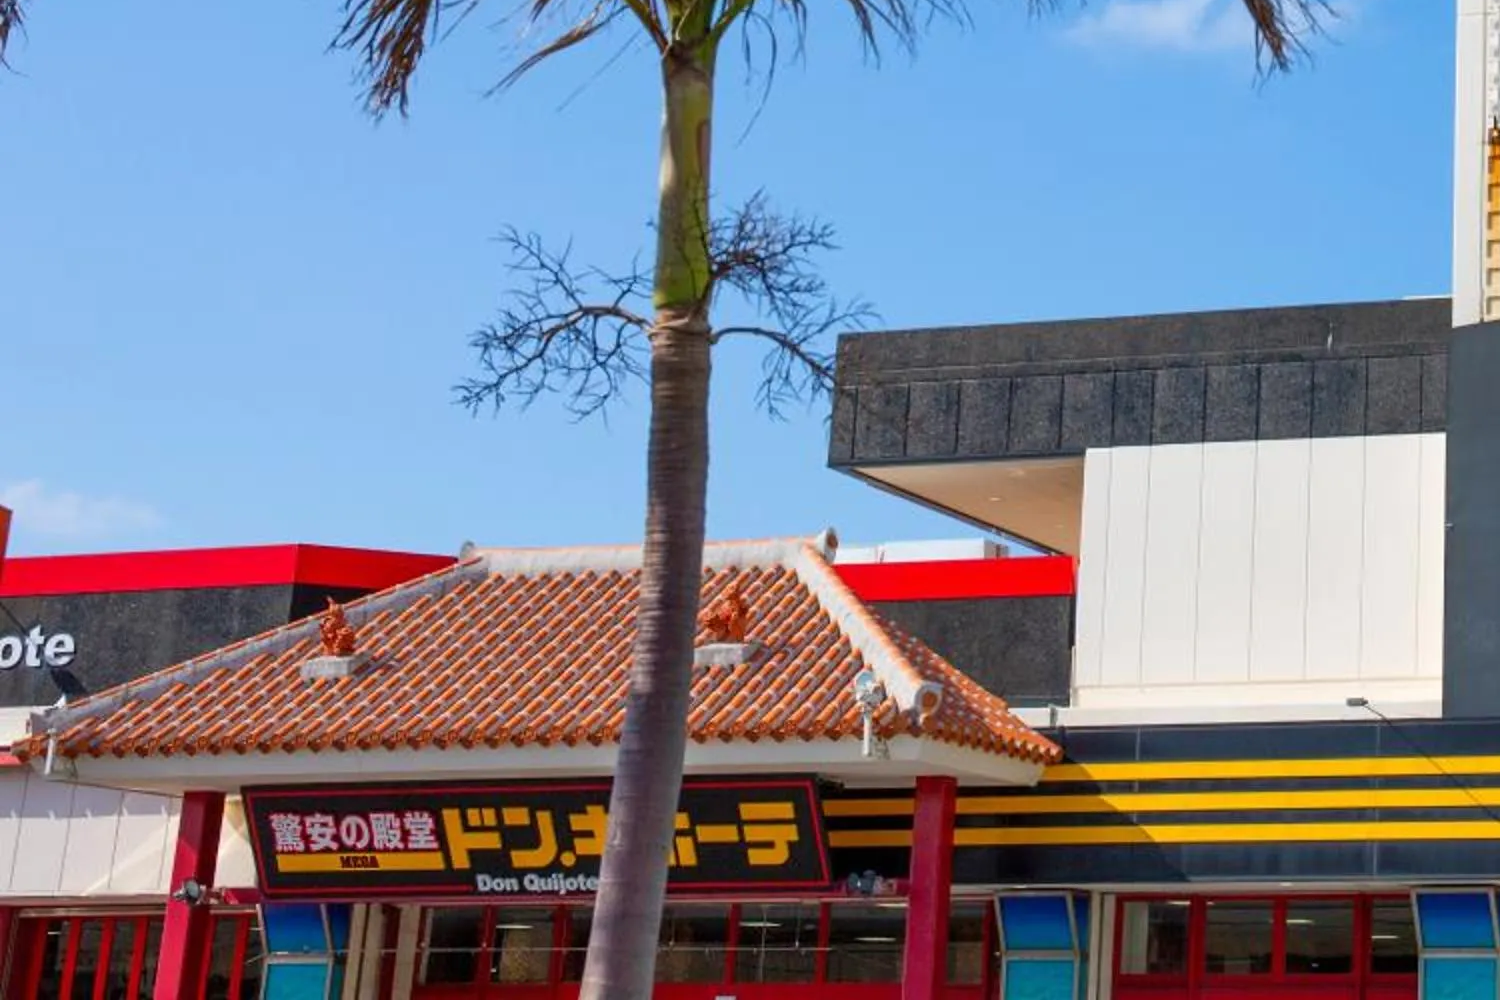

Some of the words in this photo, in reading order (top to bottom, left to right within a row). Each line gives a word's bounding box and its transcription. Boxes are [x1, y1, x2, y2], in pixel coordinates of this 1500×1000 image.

[268, 810, 439, 853] 驚安の殿堂
[476, 873, 519, 893] Don
[523, 872, 600, 896] Quijote
